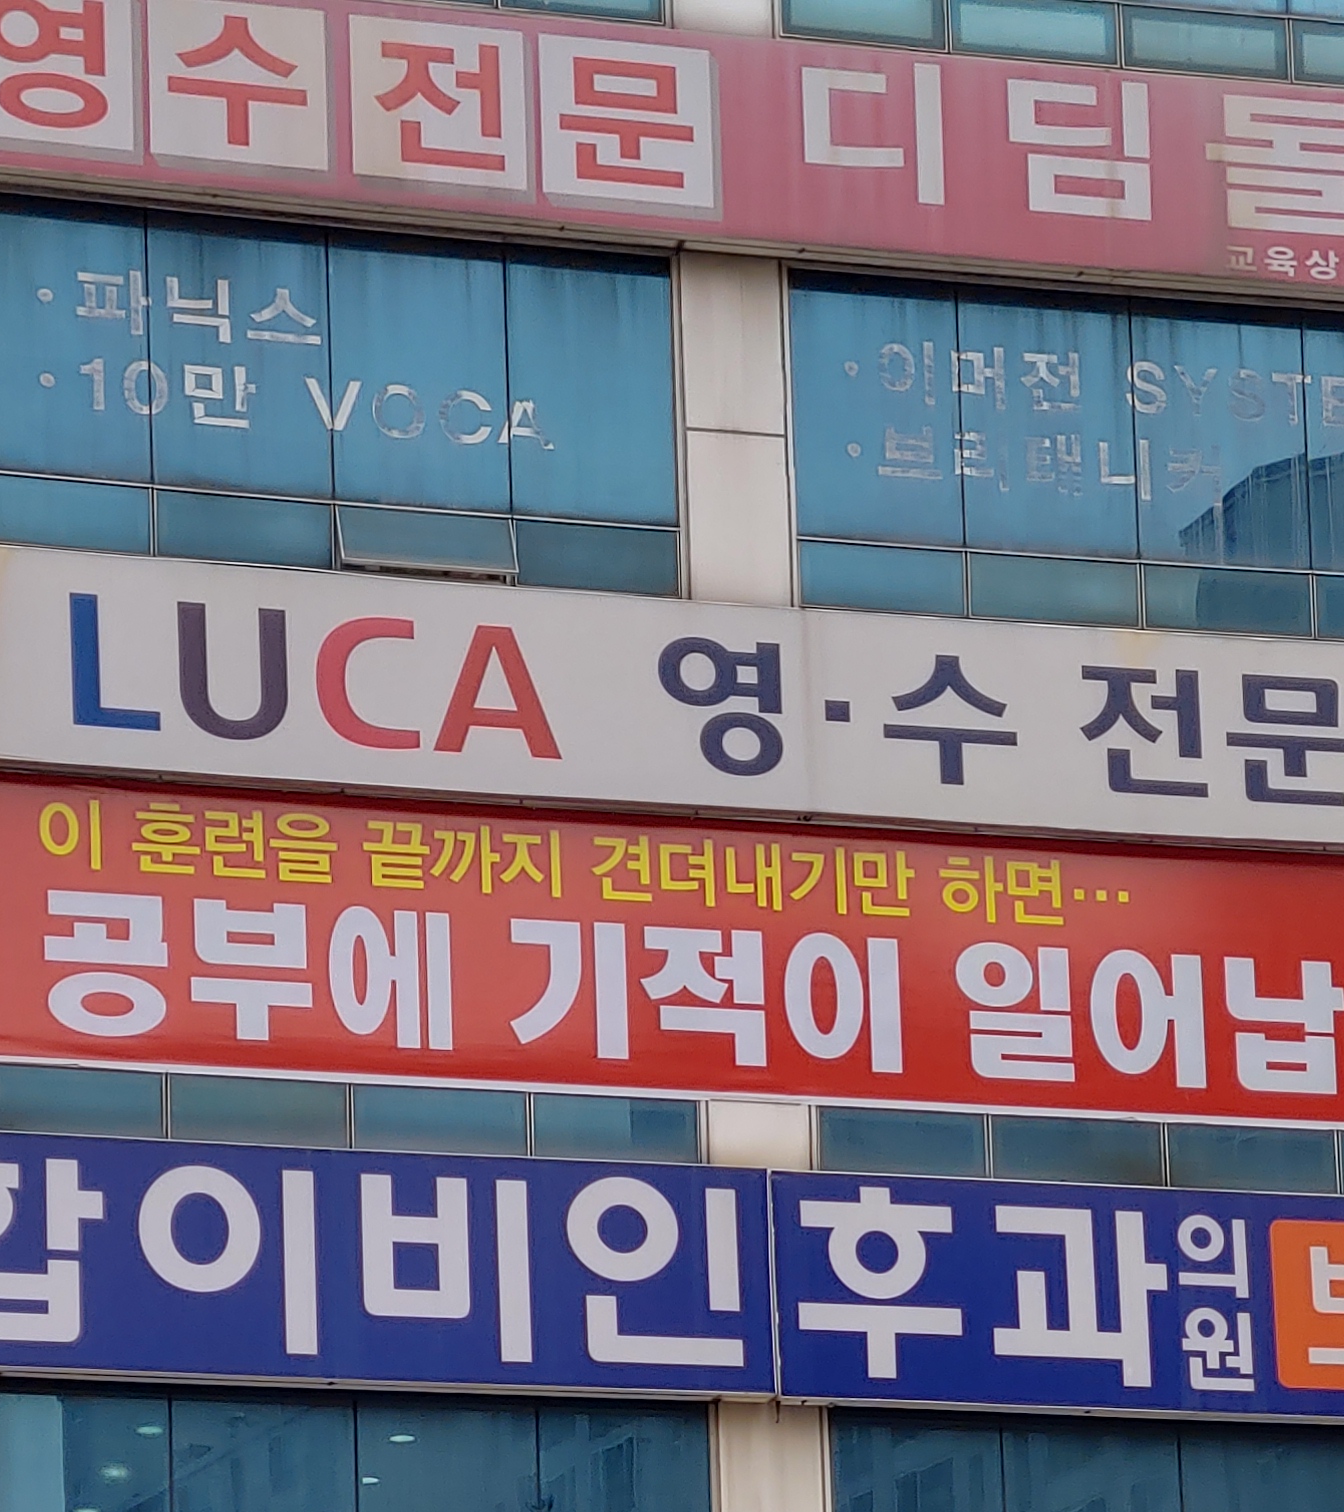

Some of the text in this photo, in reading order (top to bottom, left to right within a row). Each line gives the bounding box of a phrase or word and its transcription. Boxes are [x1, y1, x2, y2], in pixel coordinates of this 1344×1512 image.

[75, 269, 322, 346] 파닉스
[79, 358, 555, 452] 10만 VOCA
[879, 341, 1081, 412] 이머전
[69, 592, 563, 760] LUCA
[38, 799, 102, 871] 이
[130, 802, 338, 885] 훈련을
[362, 820, 563, 899] 끝까지
[591, 833, 915, 917] 견뎌내기만
[43, 888, 453, 1052] 공부에
[509, 917, 903, 1075] 기적이
